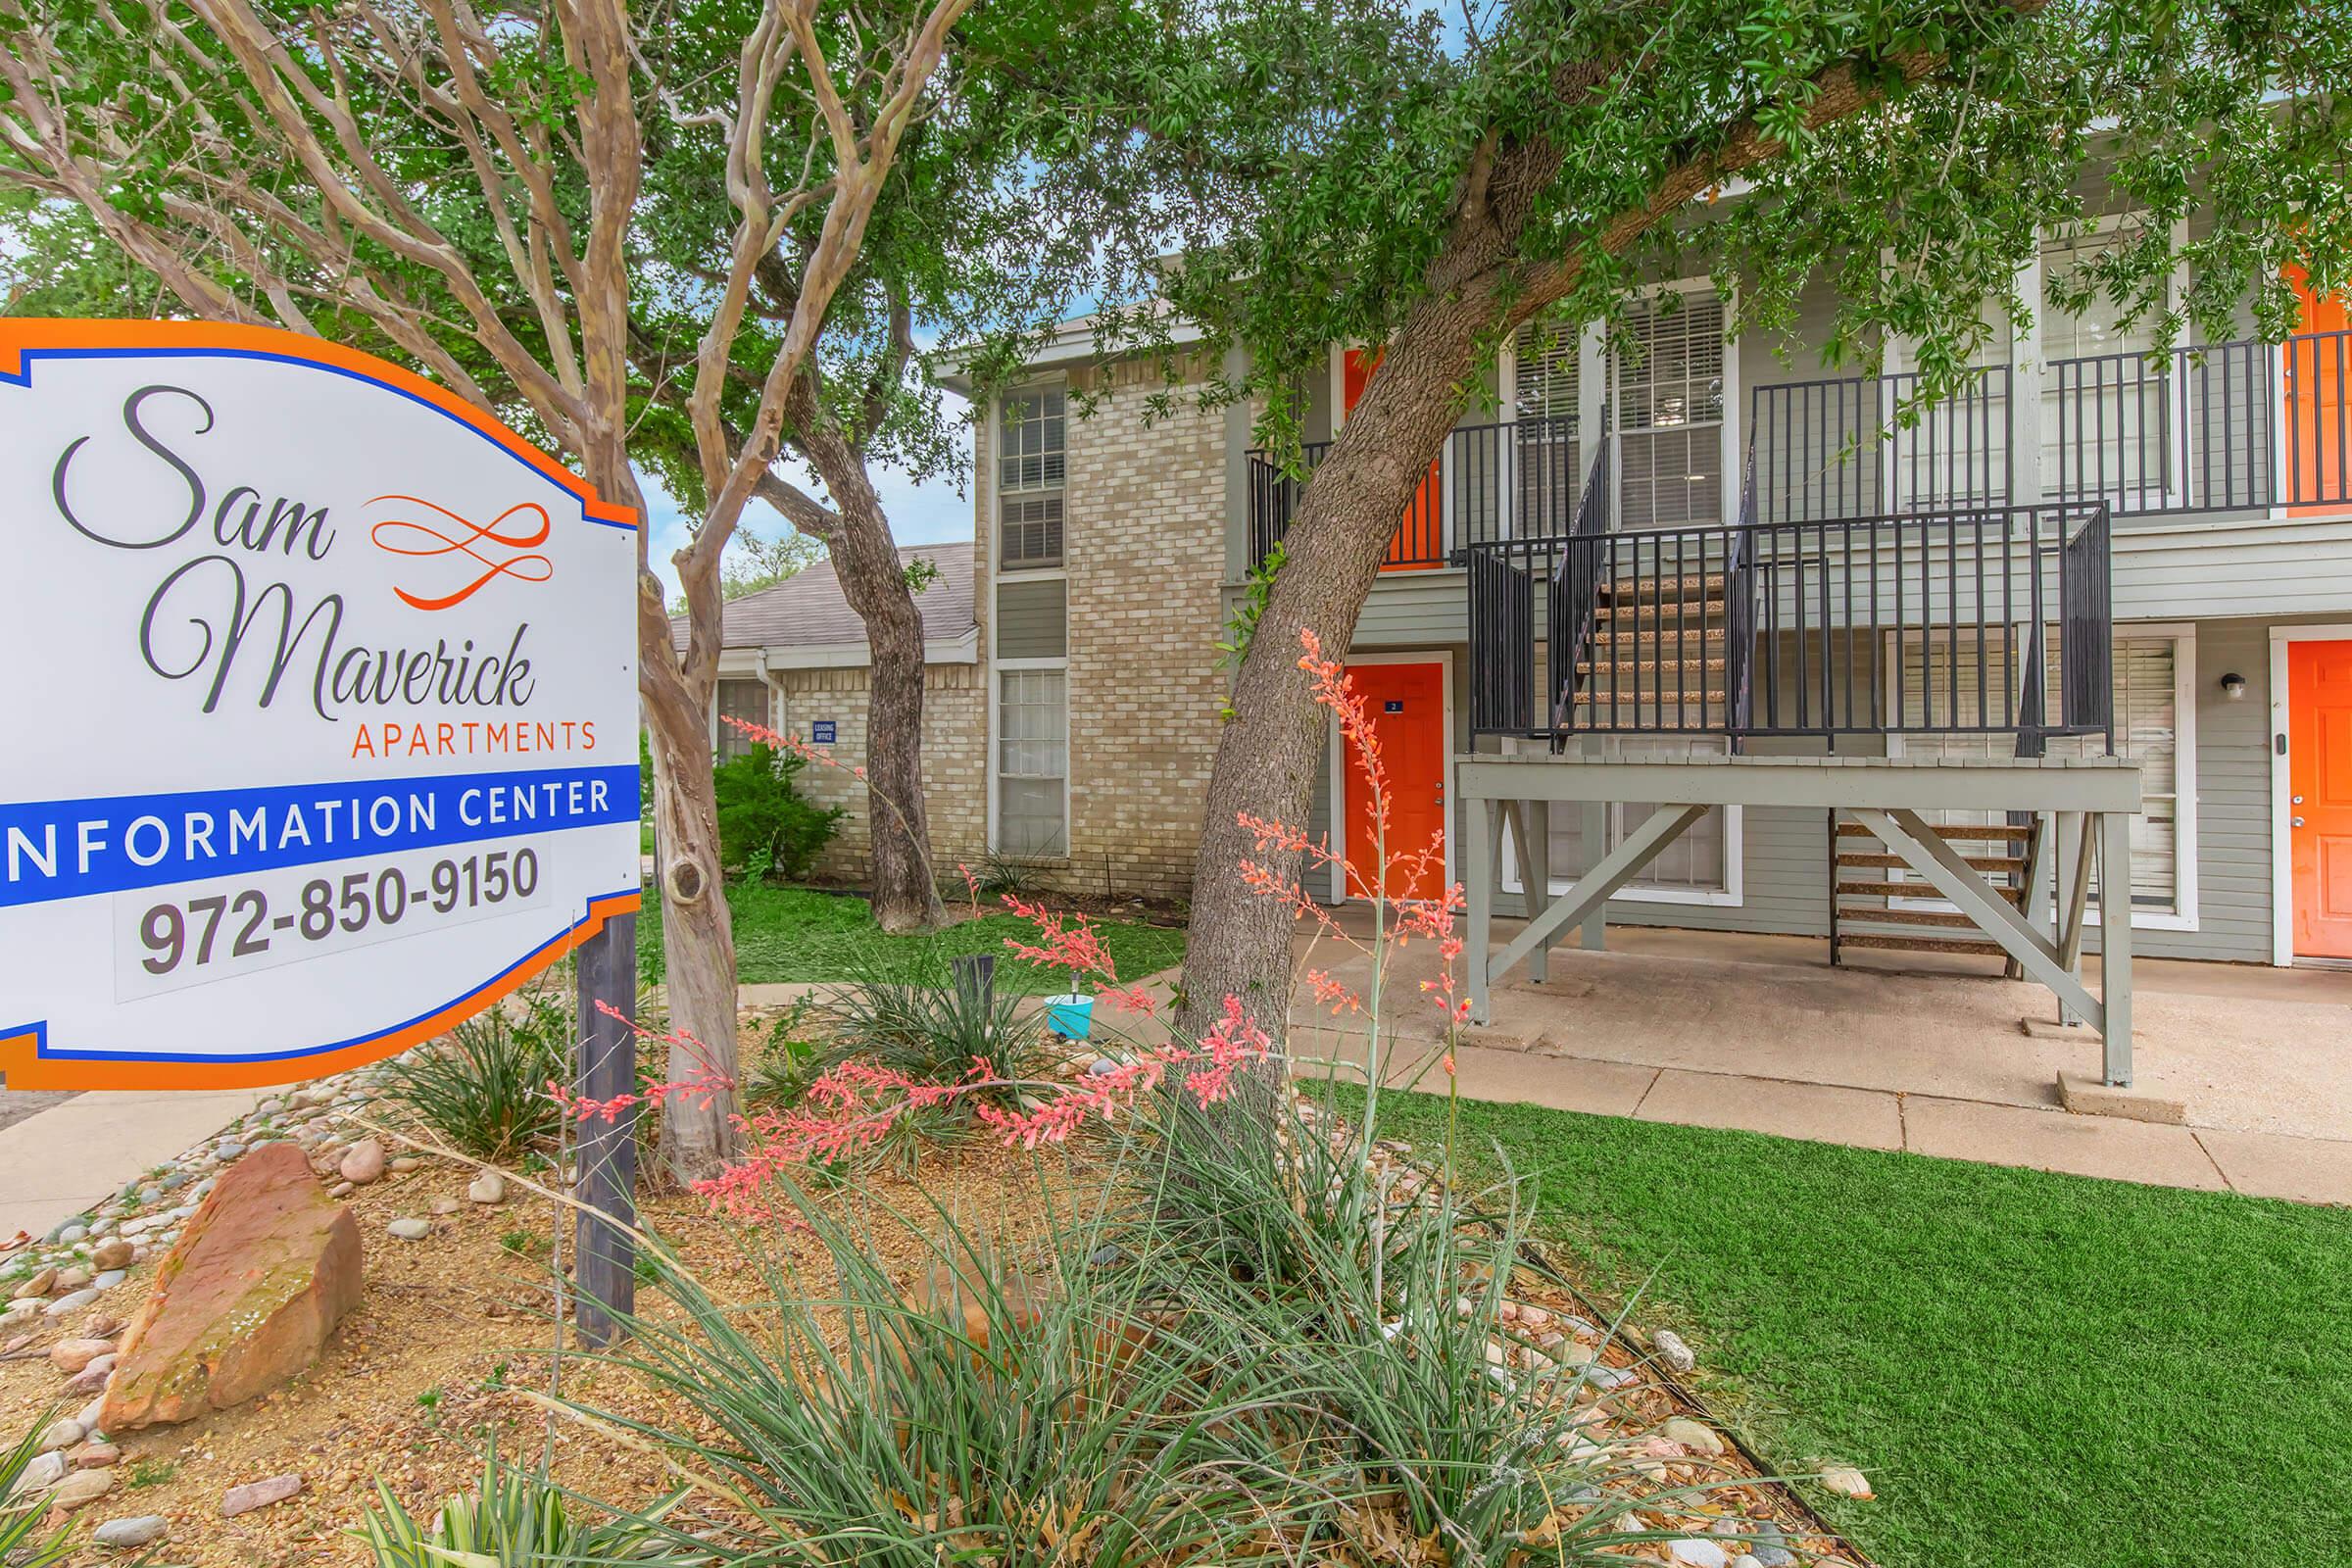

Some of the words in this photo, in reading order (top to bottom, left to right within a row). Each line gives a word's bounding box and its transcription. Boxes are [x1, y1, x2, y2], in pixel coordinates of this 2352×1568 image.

[52, 384, 337, 562] Sam
[139, 555, 536, 722] Maverick
[351, 720, 596, 760] APARTMENTS
[814, 723, 834, 732] LEASING
[815, 732, 832, 741] OFFICE
[7, 792, 435, 882] NFORMATION
[459, 779, 610, 826] CENTER
[140, 847, 538, 975] 972-850-9150
